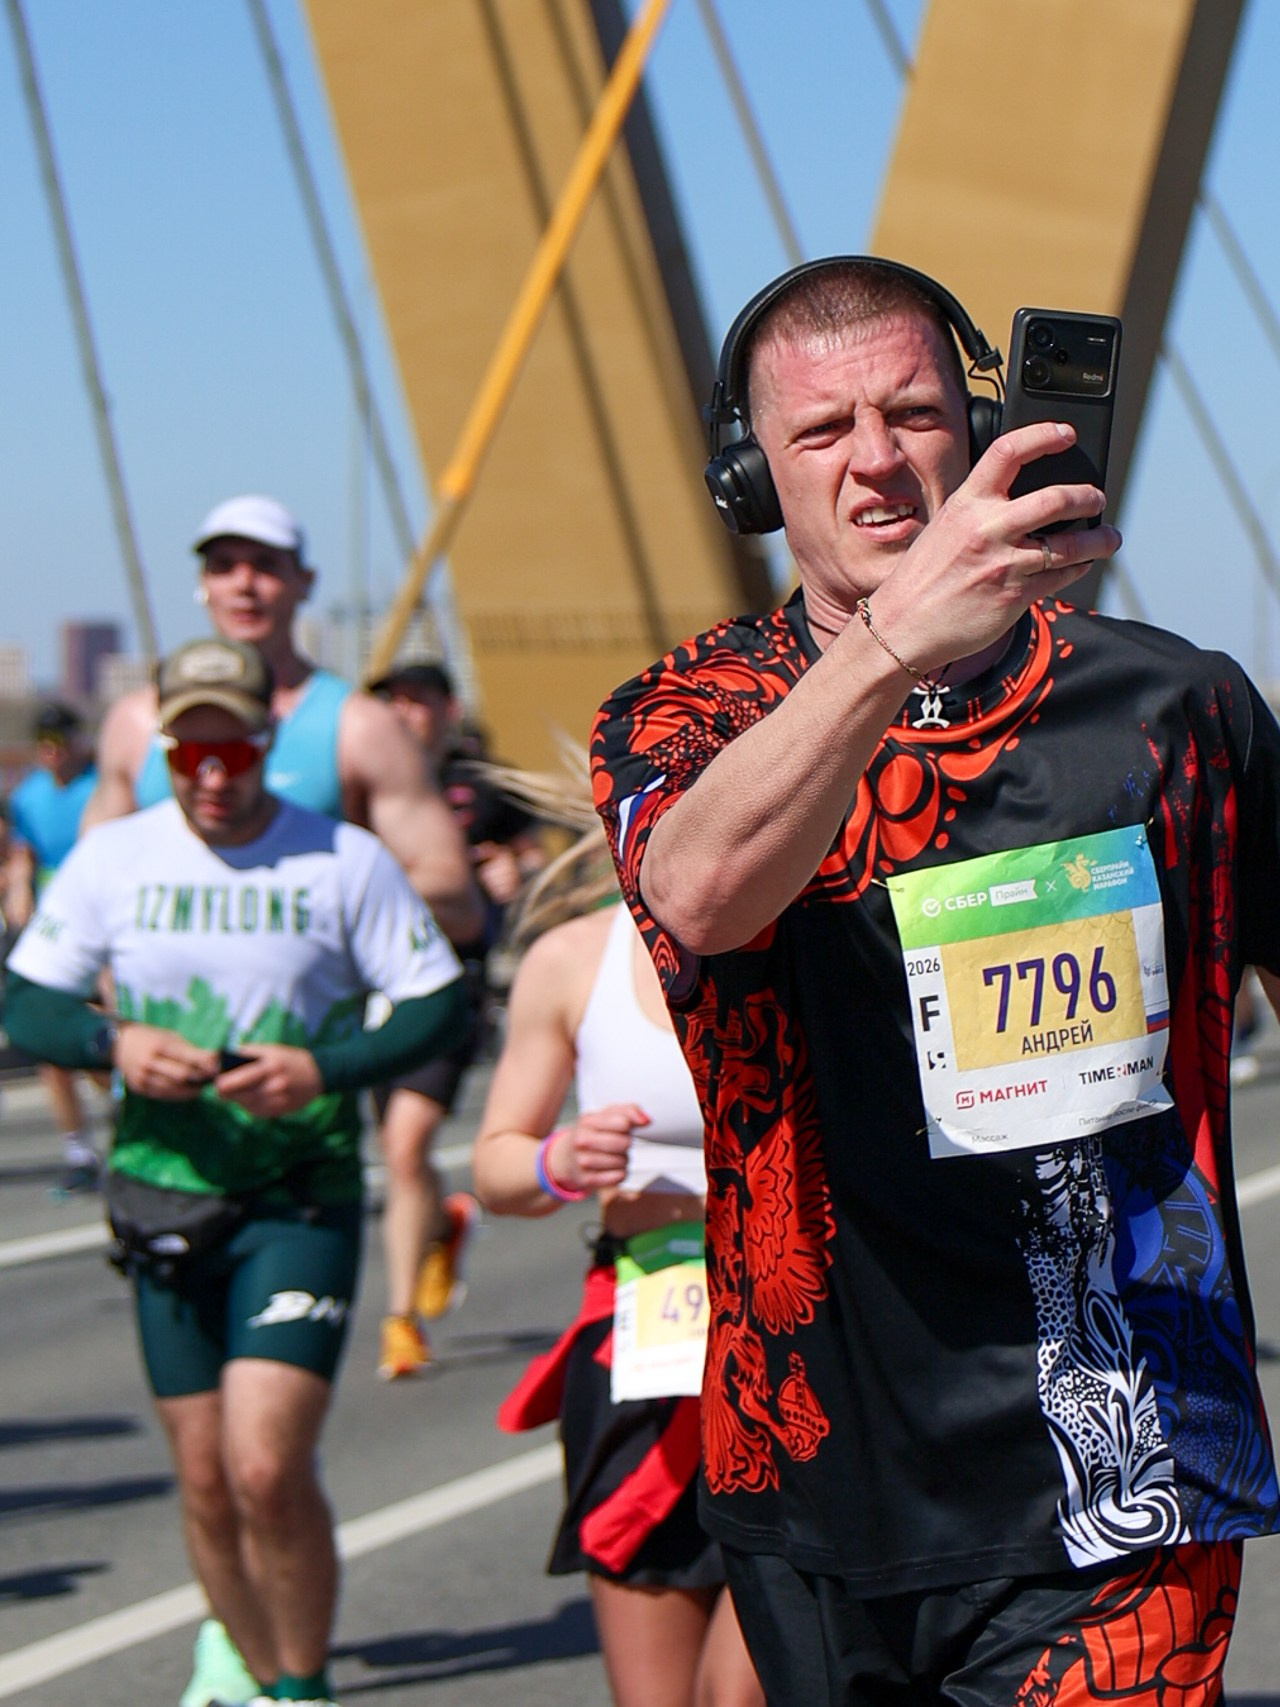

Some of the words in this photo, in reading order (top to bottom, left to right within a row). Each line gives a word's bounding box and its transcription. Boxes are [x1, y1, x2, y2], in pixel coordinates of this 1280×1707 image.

[944, 892, 988, 911] СБЕР
[995, 887, 1029, 901] Прайм
[907, 957, 941, 977] 2026
[982, 946, 1117, 1033] 7796
[919, 994, 941, 1032] F
[1021, 1019, 1094, 1055] АНДРЕЙ
[979, 1080, 1049, 1104] МАГНИТ
[971, 1132, 1008, 1143] Массаж
[661, 1284, 705, 1323] 49
